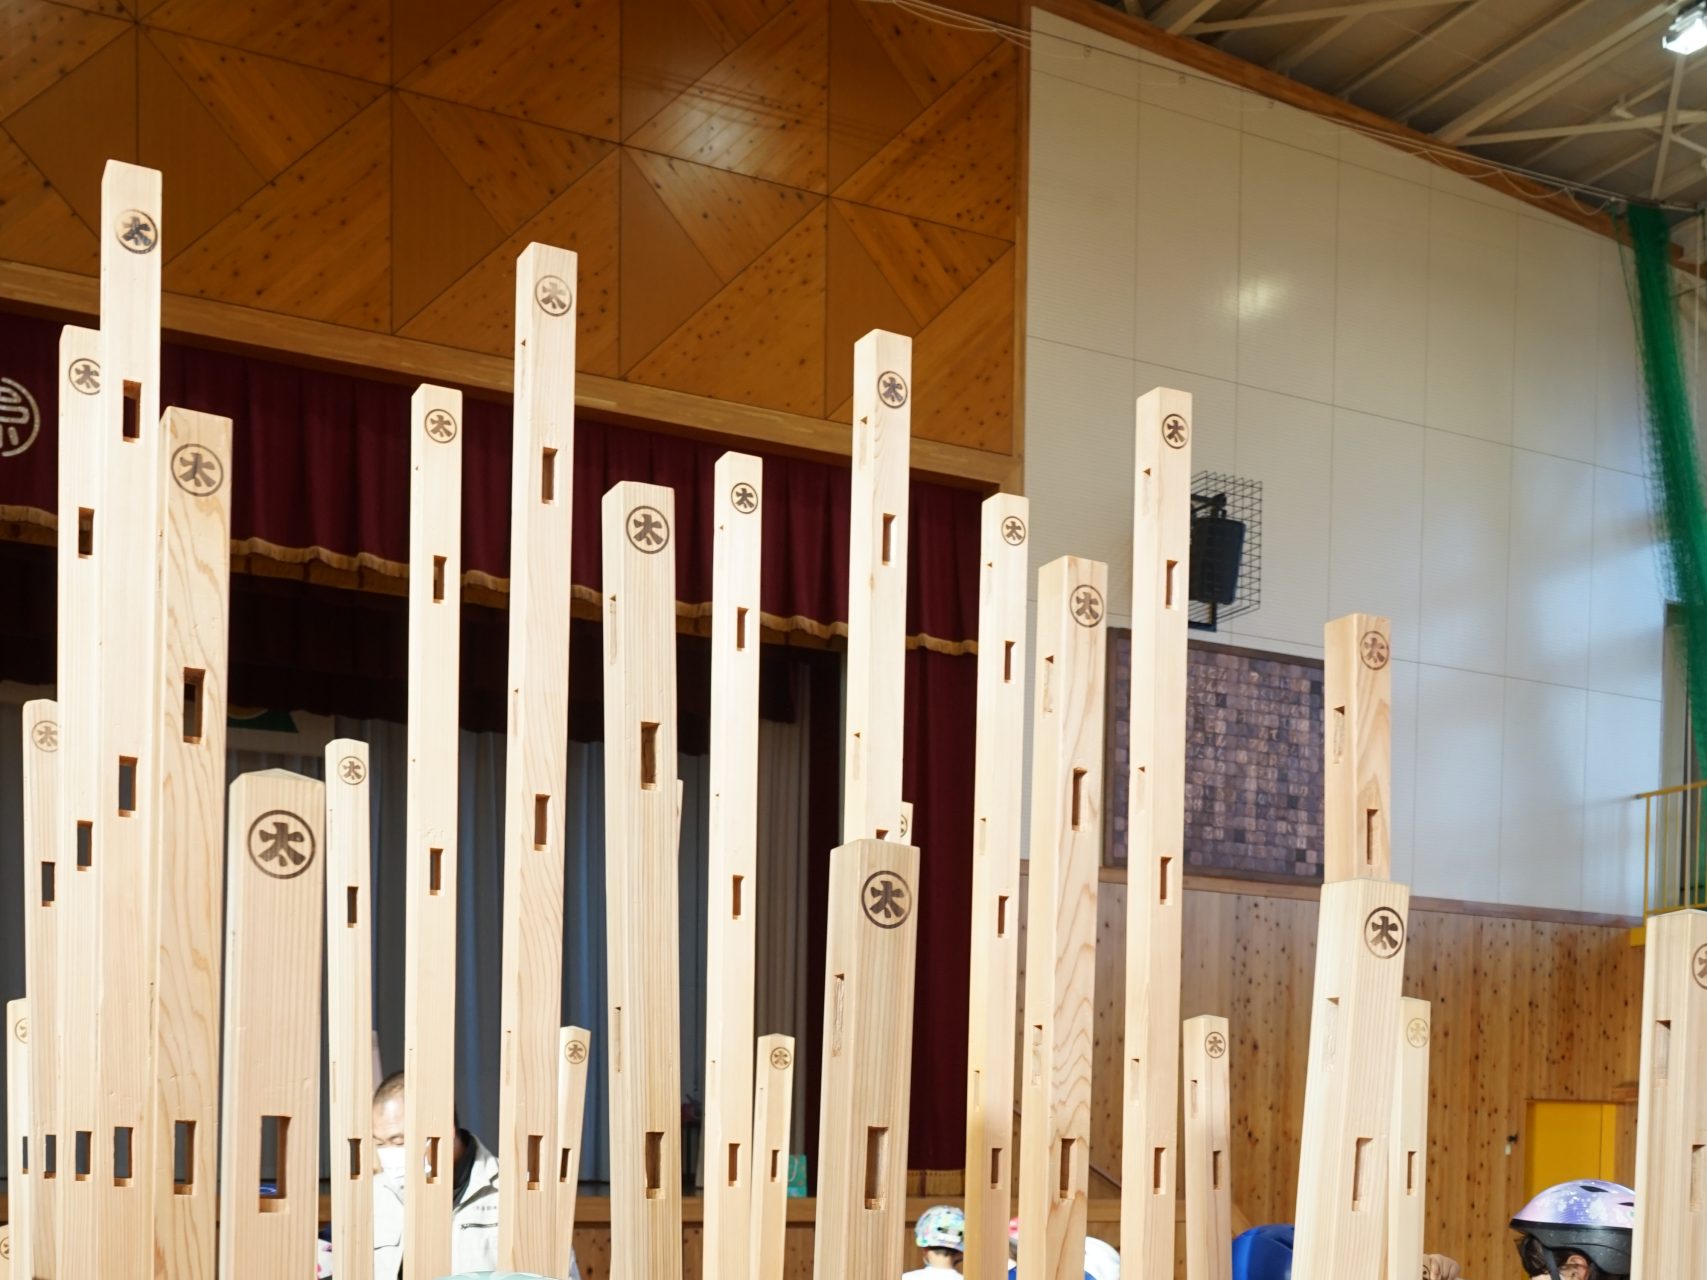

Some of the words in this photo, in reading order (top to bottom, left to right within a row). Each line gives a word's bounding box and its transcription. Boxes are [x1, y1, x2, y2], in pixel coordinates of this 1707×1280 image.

[540, 281, 568, 310] 太
[74, 363, 101, 390] 太
[880, 376, 905, 403] 太
[429, 413, 454, 438] 太
[1165, 419, 1186, 443] 太
[177, 450, 218, 489] 太
[734, 487, 756, 509] 太
[631, 511, 666, 547] 太
[1004, 520, 1023, 541] 太
[1074, 591, 1100, 621] 太
[1363, 637, 1386, 664] 太
[36, 725, 59, 747] 太
[341, 760, 363, 781] 太
[257, 820, 308, 869] 太
[867, 879, 908, 920] 太
[1369, 915, 1400, 950] 太
[567, 1043, 585, 1061] 太
[1207, 1036, 1224, 1054] 太
